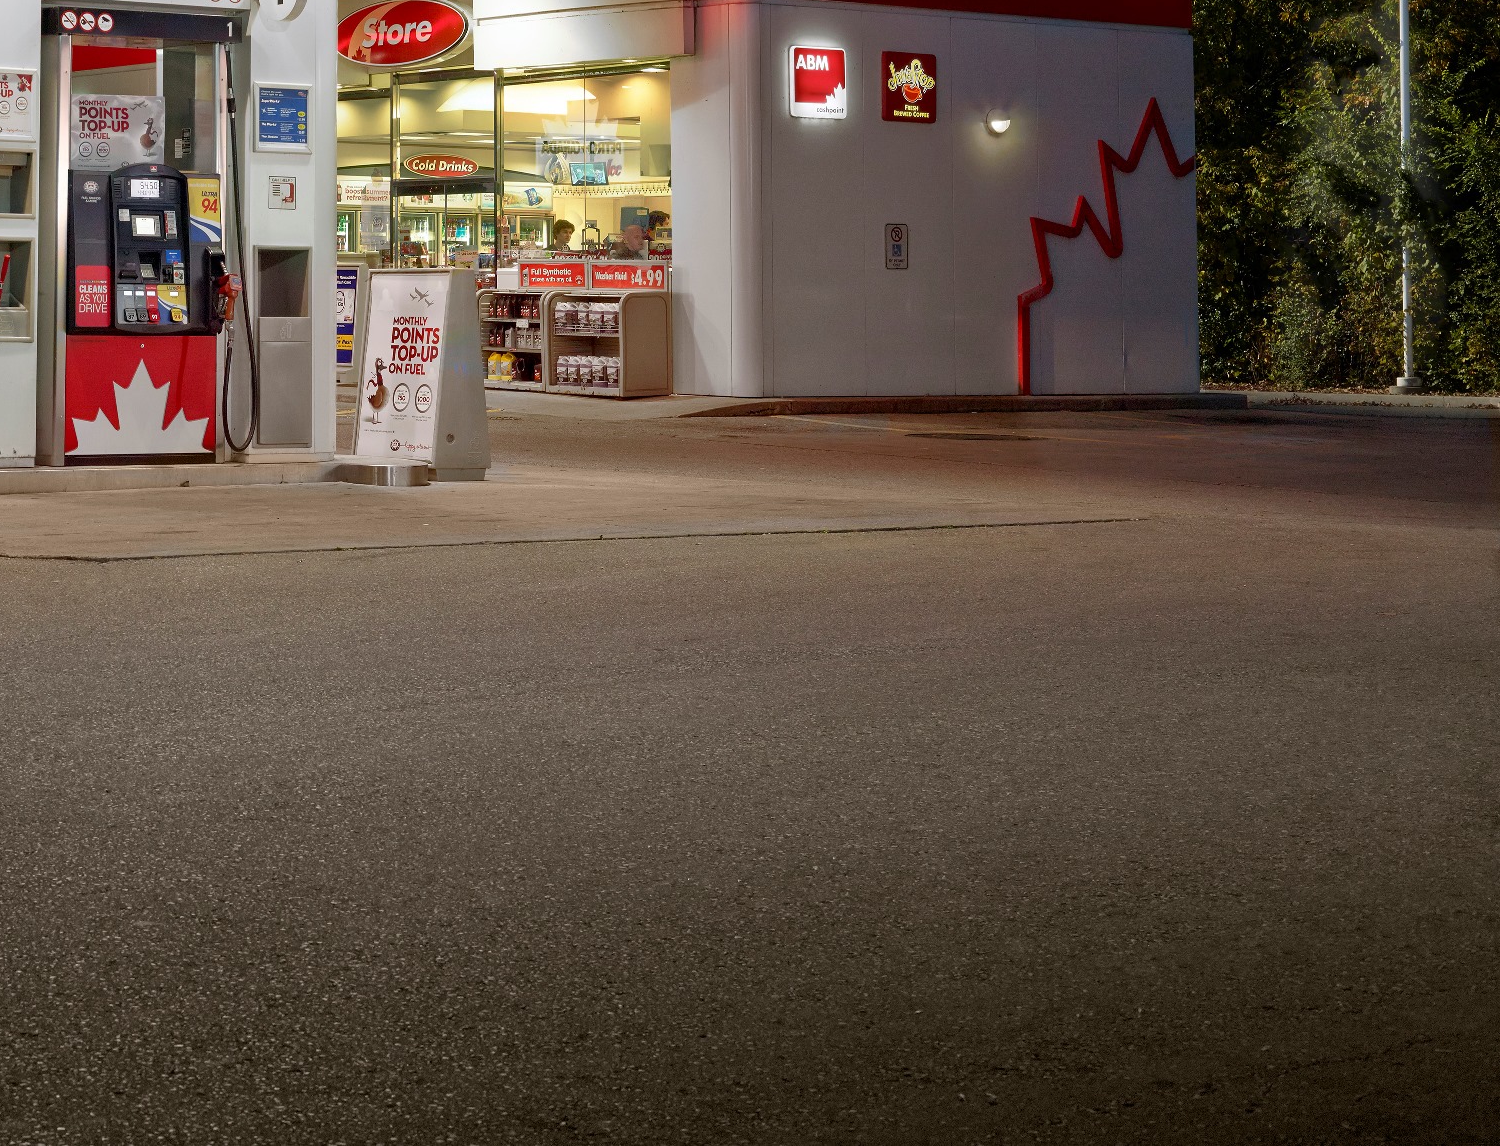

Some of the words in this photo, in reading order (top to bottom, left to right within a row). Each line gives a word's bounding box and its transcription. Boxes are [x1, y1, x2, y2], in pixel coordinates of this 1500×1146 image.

[226, 22, 234, 38] 1
[361, 17, 433, 48] Store
[795, 54, 829, 71] ABM
[79, 106, 129, 121] POINTS
[79, 119, 130, 133] TOP-UP
[412, 158, 437, 172] Cold
[438, 159, 474, 174] Drinks
[201, 197, 218, 214] 94
[542, 268, 571, 276] Synthetic
[595, 271, 614, 280] Washer
[615, 271, 627, 280] Fluid
[631, 269, 663, 286] $4.99
[79, 285, 107, 293] CLEANS
[79, 294, 90, 303] AS
[92, 294, 108, 303] YOU
[79, 303, 108, 313] DRIVE
[392, 316, 428, 326] MONTHLY
[391, 327, 440, 345] POINTS
[390, 344, 439, 363] TOP-UP
[388, 362, 402, 375] ON
[404, 363, 426, 375] FUEL
